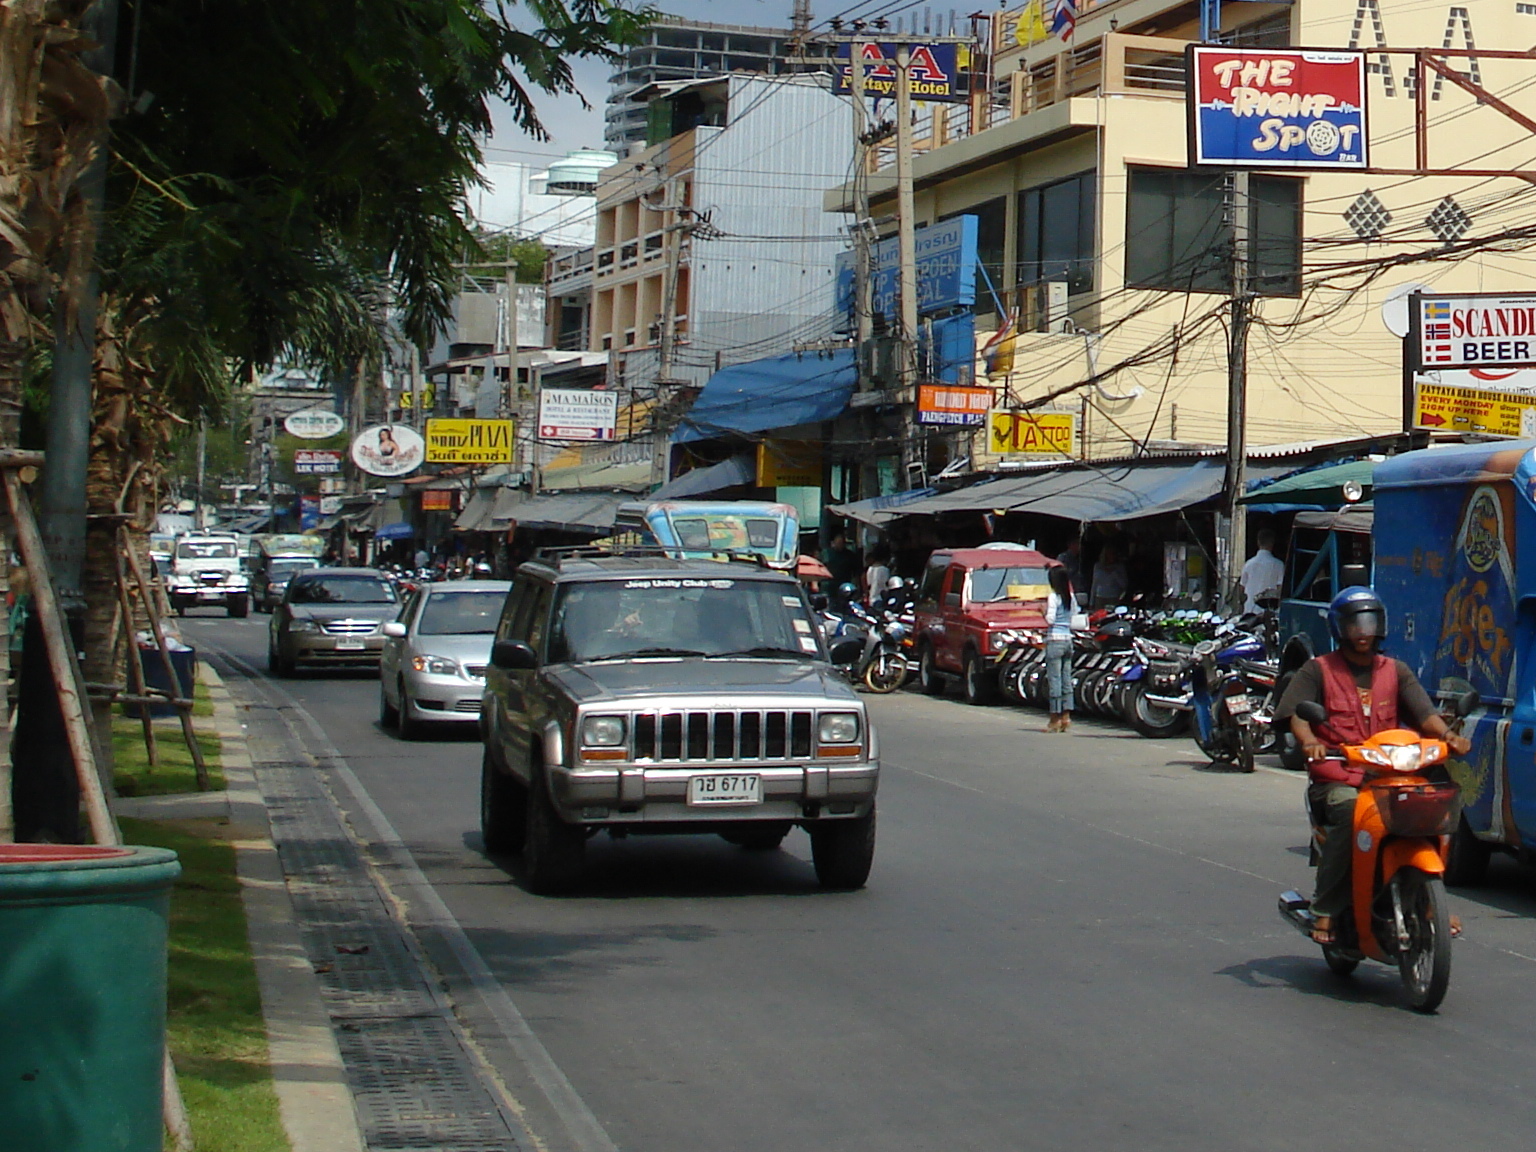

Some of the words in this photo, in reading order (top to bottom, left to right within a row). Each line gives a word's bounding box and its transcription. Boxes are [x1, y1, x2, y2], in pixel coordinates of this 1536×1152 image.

[1213, 59, 1296, 88] THE
[908, 80, 950, 96] Hotel
[1463, 341, 1530, 361] BEER
[1421, 384, 1457, 397] PATTAYA
[1421, 395, 1451, 404] EVERY
[1454, 399, 1494, 409] MONDAY
[1421, 403, 1445, 411] SIGN
[624, 580, 651, 589] Jeep
[652, 580, 680, 589] Unity
[682, 579, 708, 588] Club
[722, 776, 757, 791] 6717
